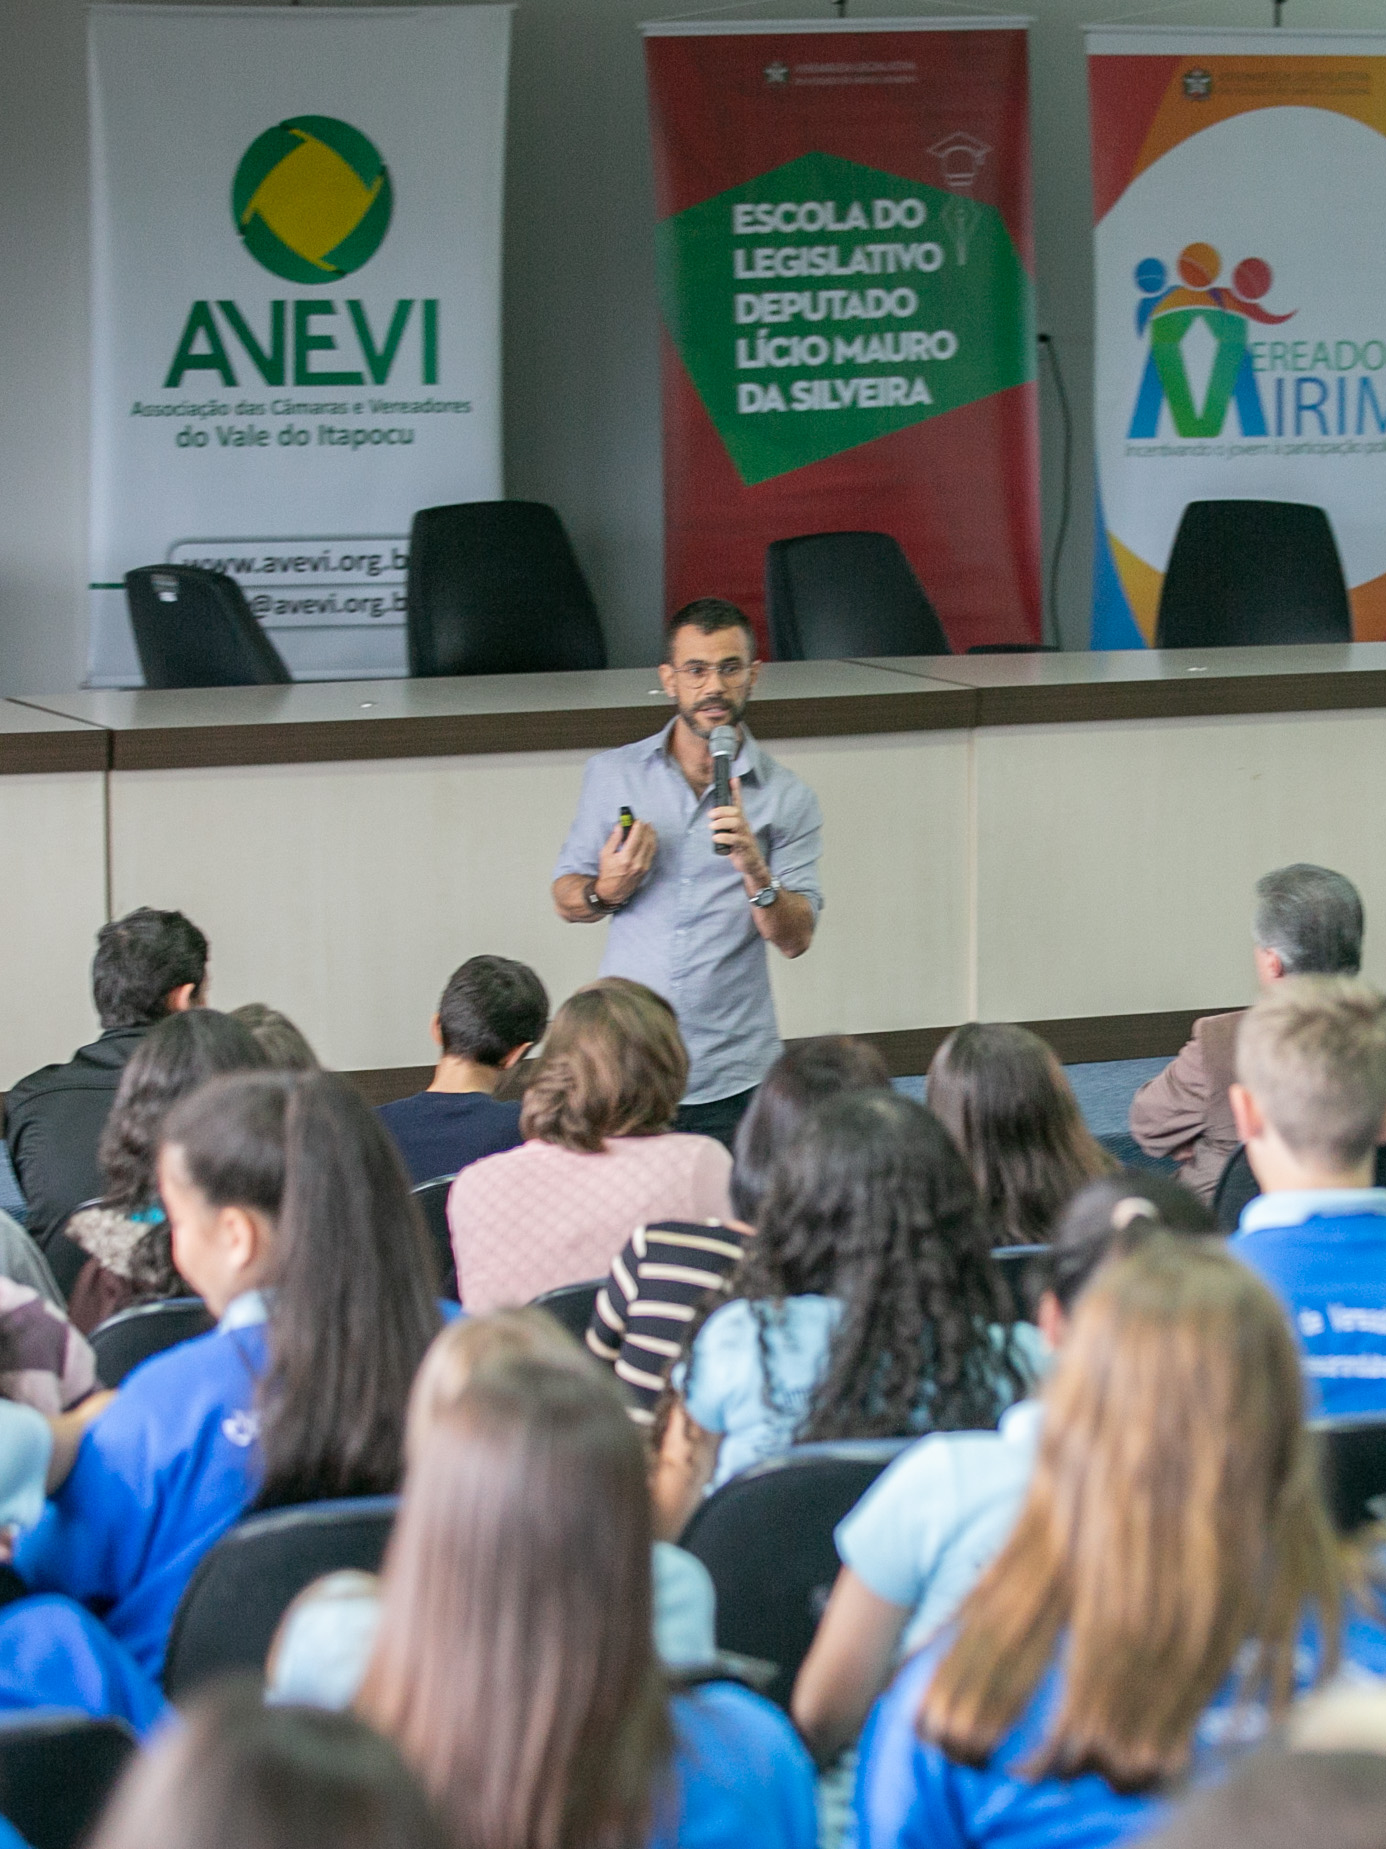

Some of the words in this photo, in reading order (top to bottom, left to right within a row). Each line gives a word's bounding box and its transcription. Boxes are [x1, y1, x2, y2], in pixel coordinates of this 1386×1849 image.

[732, 201, 870, 235] ESCOLA
[874, 198, 927, 231] DO
[733, 242, 945, 280] LEGISLATIVO
[734, 287, 918, 325] DEPUTADO
[163, 299, 440, 389] AVEVI
[735, 329, 830, 370] LÍCIO
[833, 330, 959, 365] MAURO
[130, 400, 229, 419] Associação
[234, 400, 266, 416] das
[270, 396, 348, 416] Câmaras
[351, 402, 363, 415] e
[366, 397, 471, 415] Vereadores
[737, 382, 787, 415] DA
[790, 376, 934, 412] SILVEIRA
[176, 425, 209, 449] do
[215, 425, 269, 448] Vale
[277, 424, 311, 447] do
[316, 424, 416, 451] Itapocu
[183, 549, 409, 577] www.avevi.org.b
[250, 592, 409, 618] @avevi.org.b
